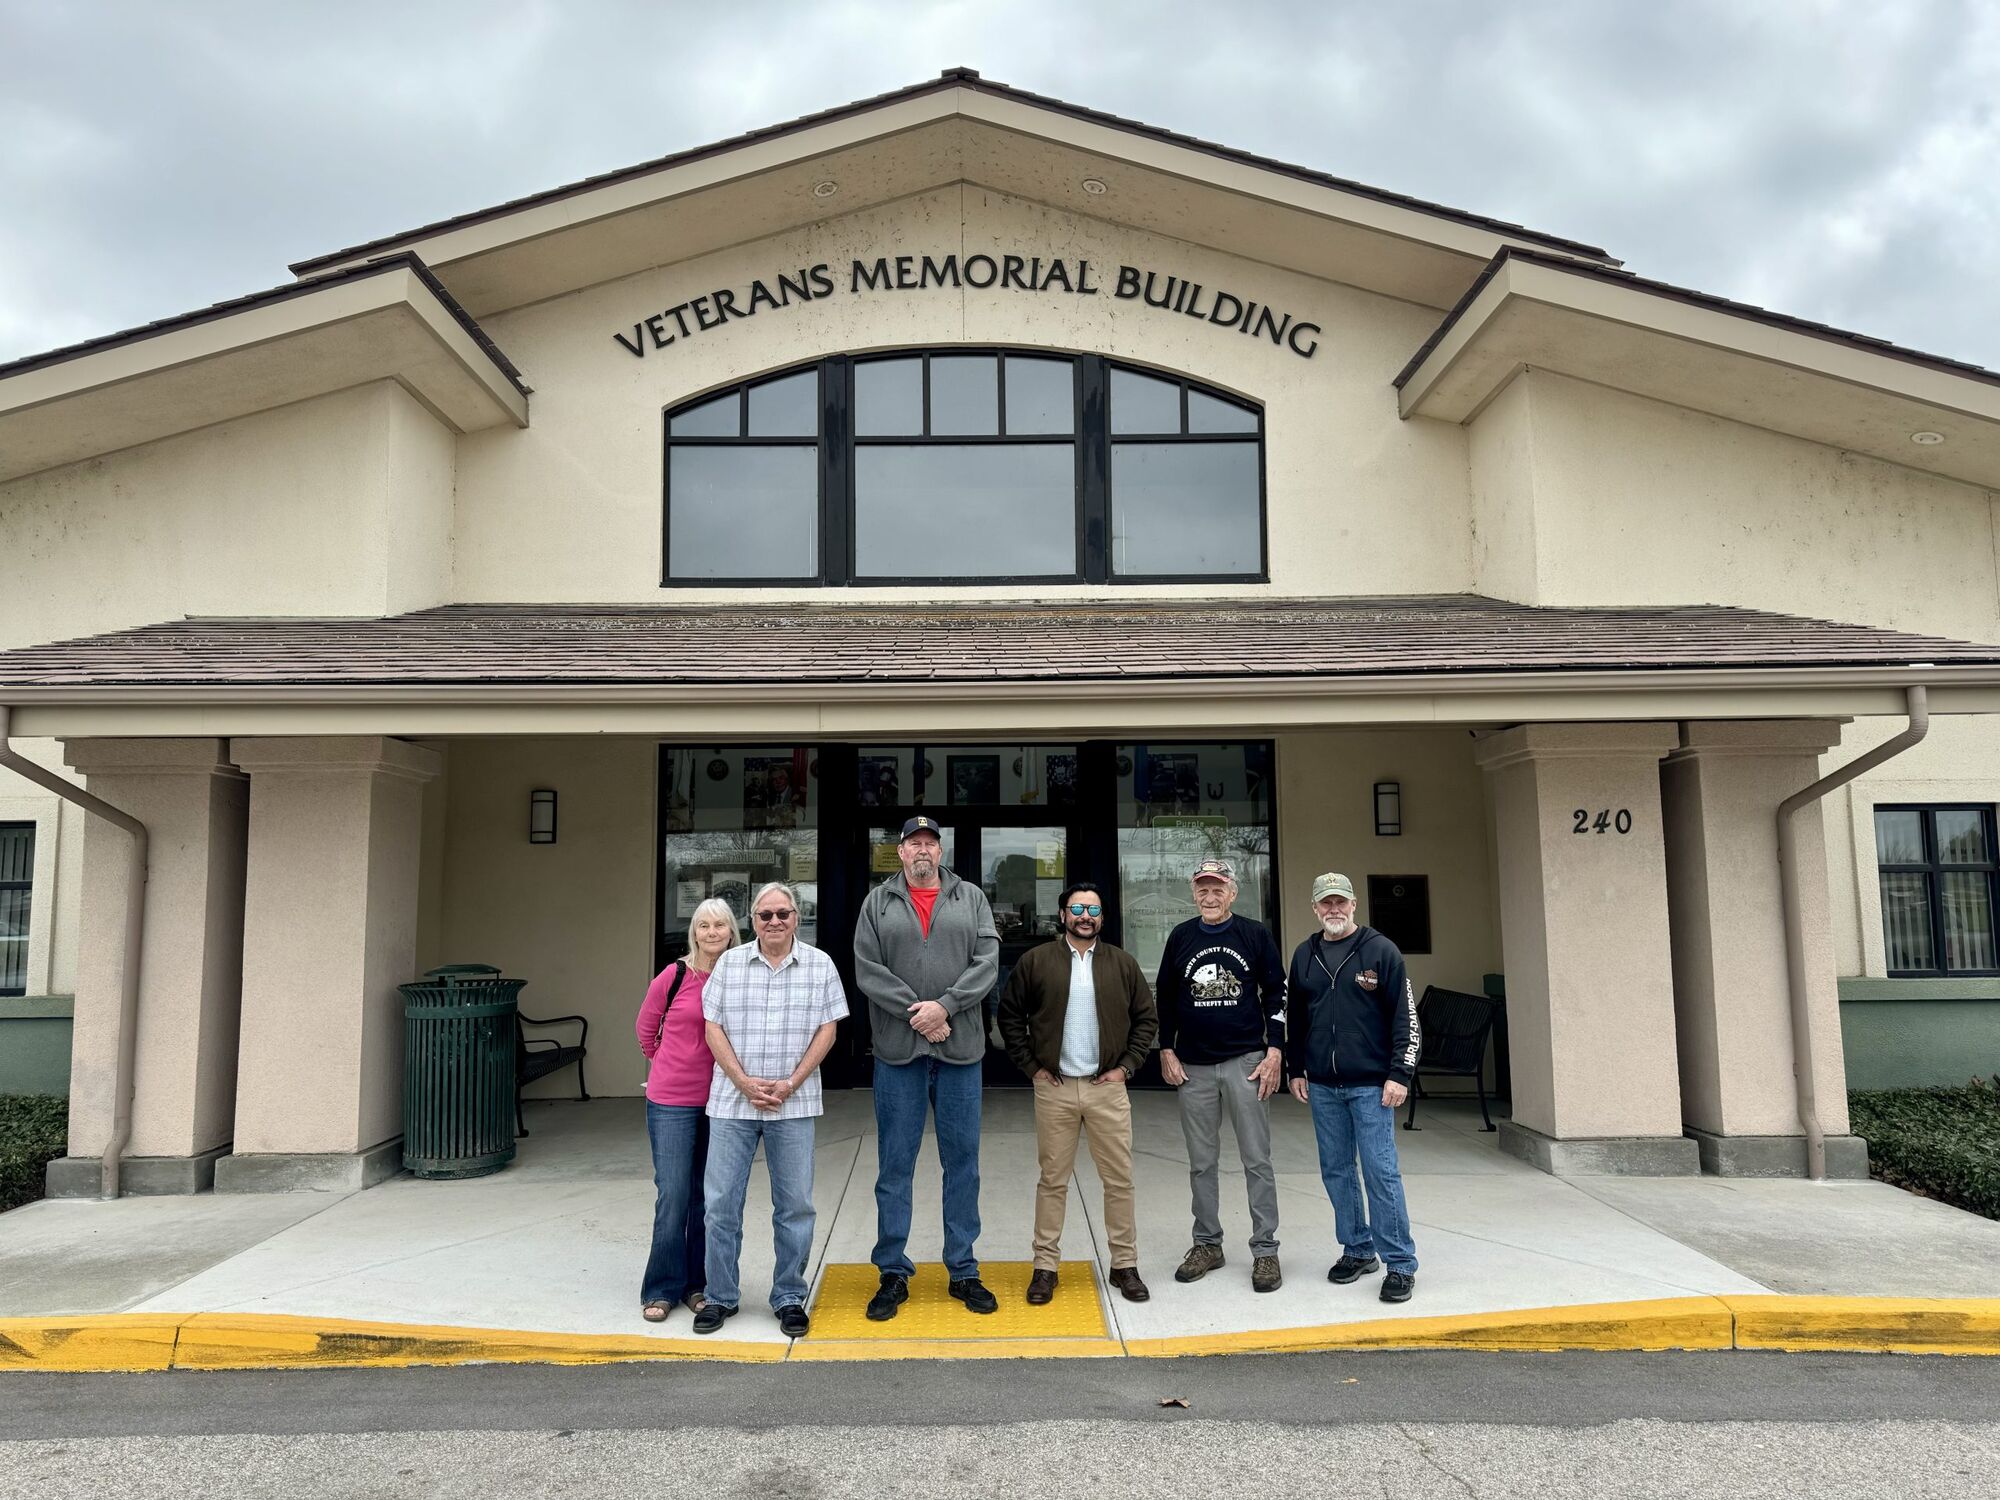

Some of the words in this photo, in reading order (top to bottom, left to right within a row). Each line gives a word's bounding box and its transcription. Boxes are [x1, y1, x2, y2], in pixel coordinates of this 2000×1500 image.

[613, 263, 834, 358] VETERANS
[850, 253, 1099, 294] MEMORIAL
[1114, 265, 1322, 359] BUILDING
[1175, 820, 1205, 829] Purple
[1572, 808, 1632, 835] 240
[1196, 946, 1221, 959] COUNTY
[1194, 1000, 1222, 1008] BENEFIT
[1403, 977, 1420, 1067] HARLEY-DAVIDSON
